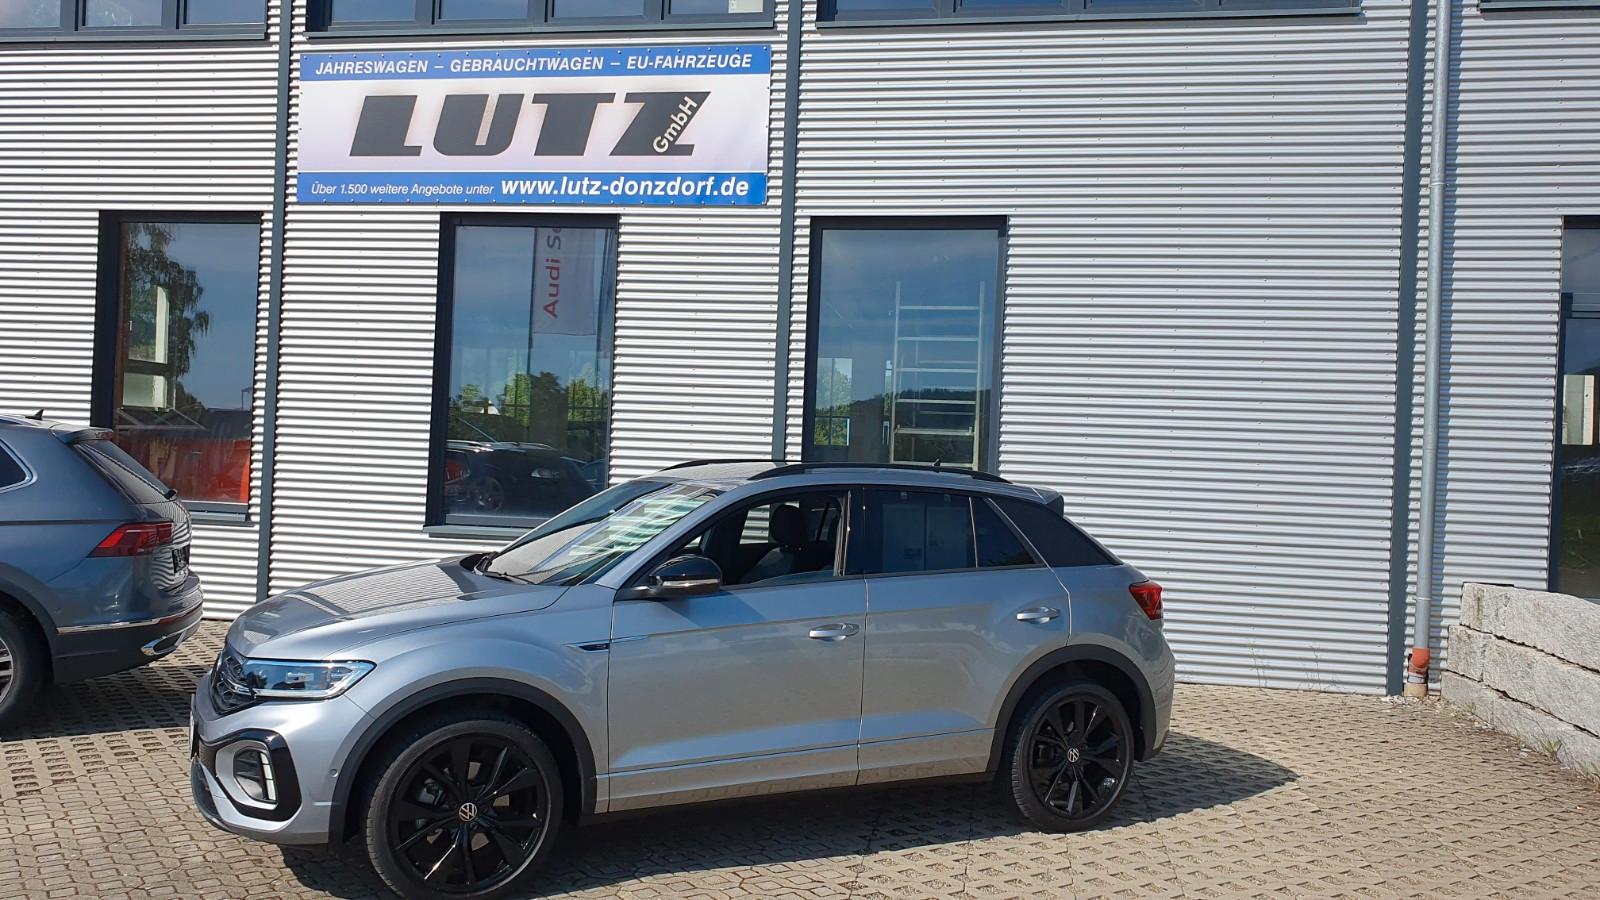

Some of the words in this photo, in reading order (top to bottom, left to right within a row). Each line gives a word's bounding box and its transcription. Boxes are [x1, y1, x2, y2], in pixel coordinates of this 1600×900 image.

[315, 60, 428, 75] JAHRESWAGEN
[450, 57, 604, 73] GEBRAUCHTWAGEN
[626, 54, 753, 70] EU-FAHRZEUGE
[349, 91, 711, 157] LUTZ
[652, 96, 698, 154] GmbH
[311, 181, 337, 195] Über
[340, 183, 367, 194] 1.500
[370, 183, 409, 194] weitere
[410, 183, 463, 197] Angebote
[465, 184, 494, 195] unter
[501, 176, 750, 197] www.lutz-donzdorf.de
[544, 258, 561, 319] Audi
